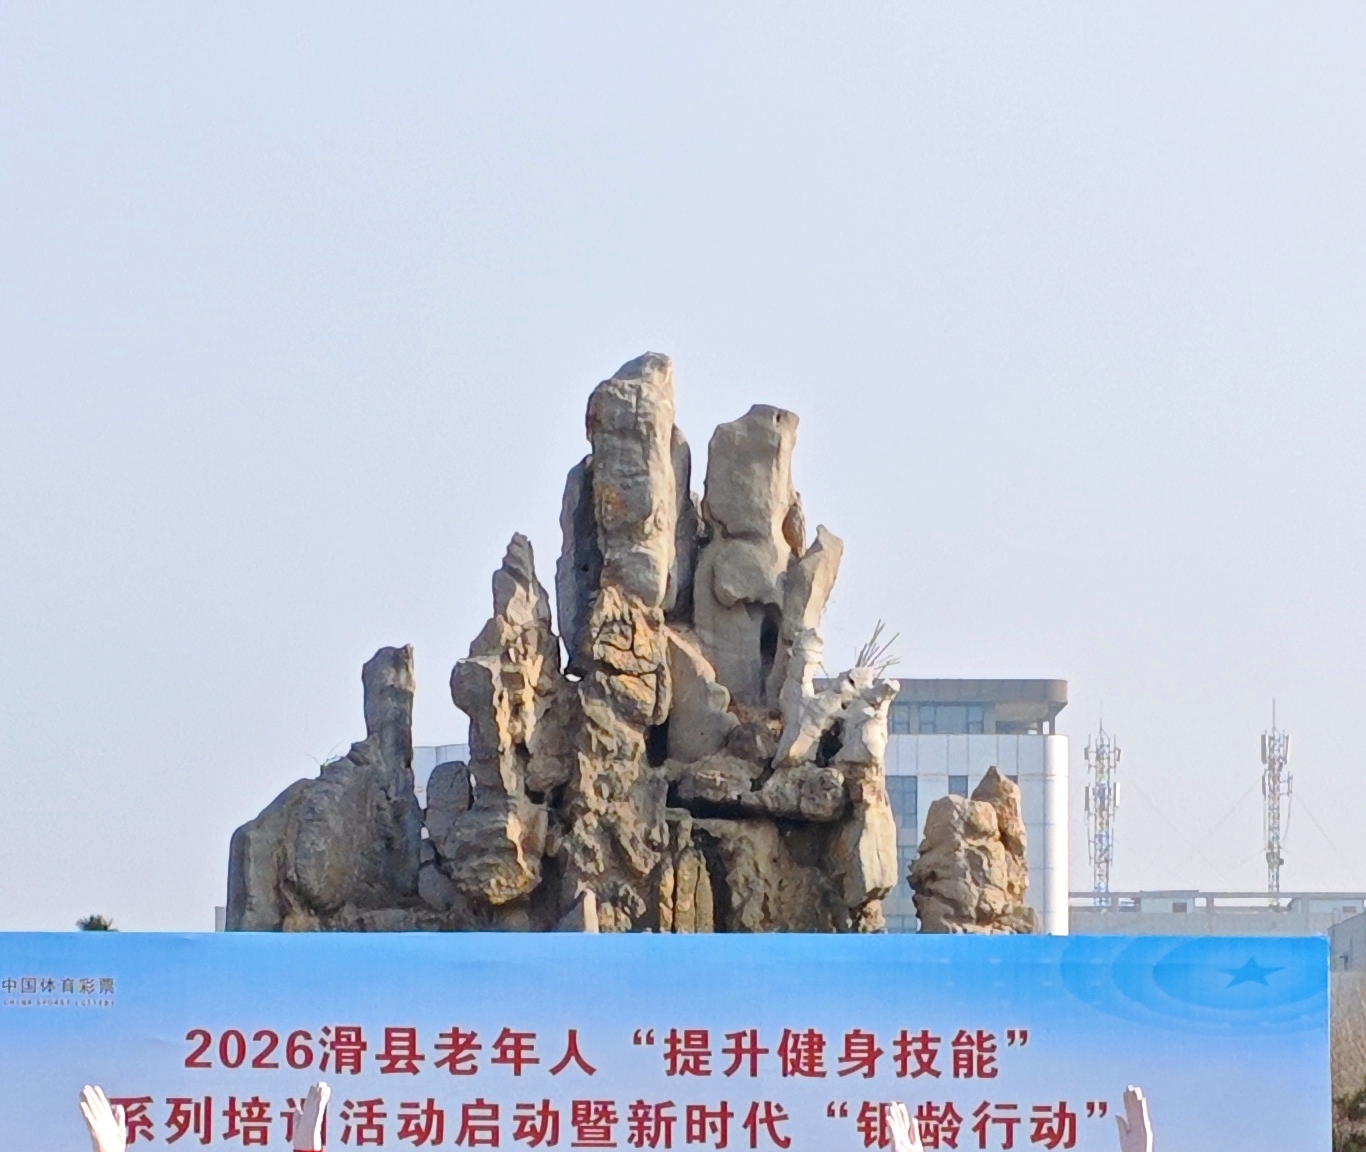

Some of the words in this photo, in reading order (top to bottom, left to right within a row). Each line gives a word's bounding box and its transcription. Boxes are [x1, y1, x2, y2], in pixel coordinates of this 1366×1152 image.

[1, 977, 115, 995] 中国体育彩票
